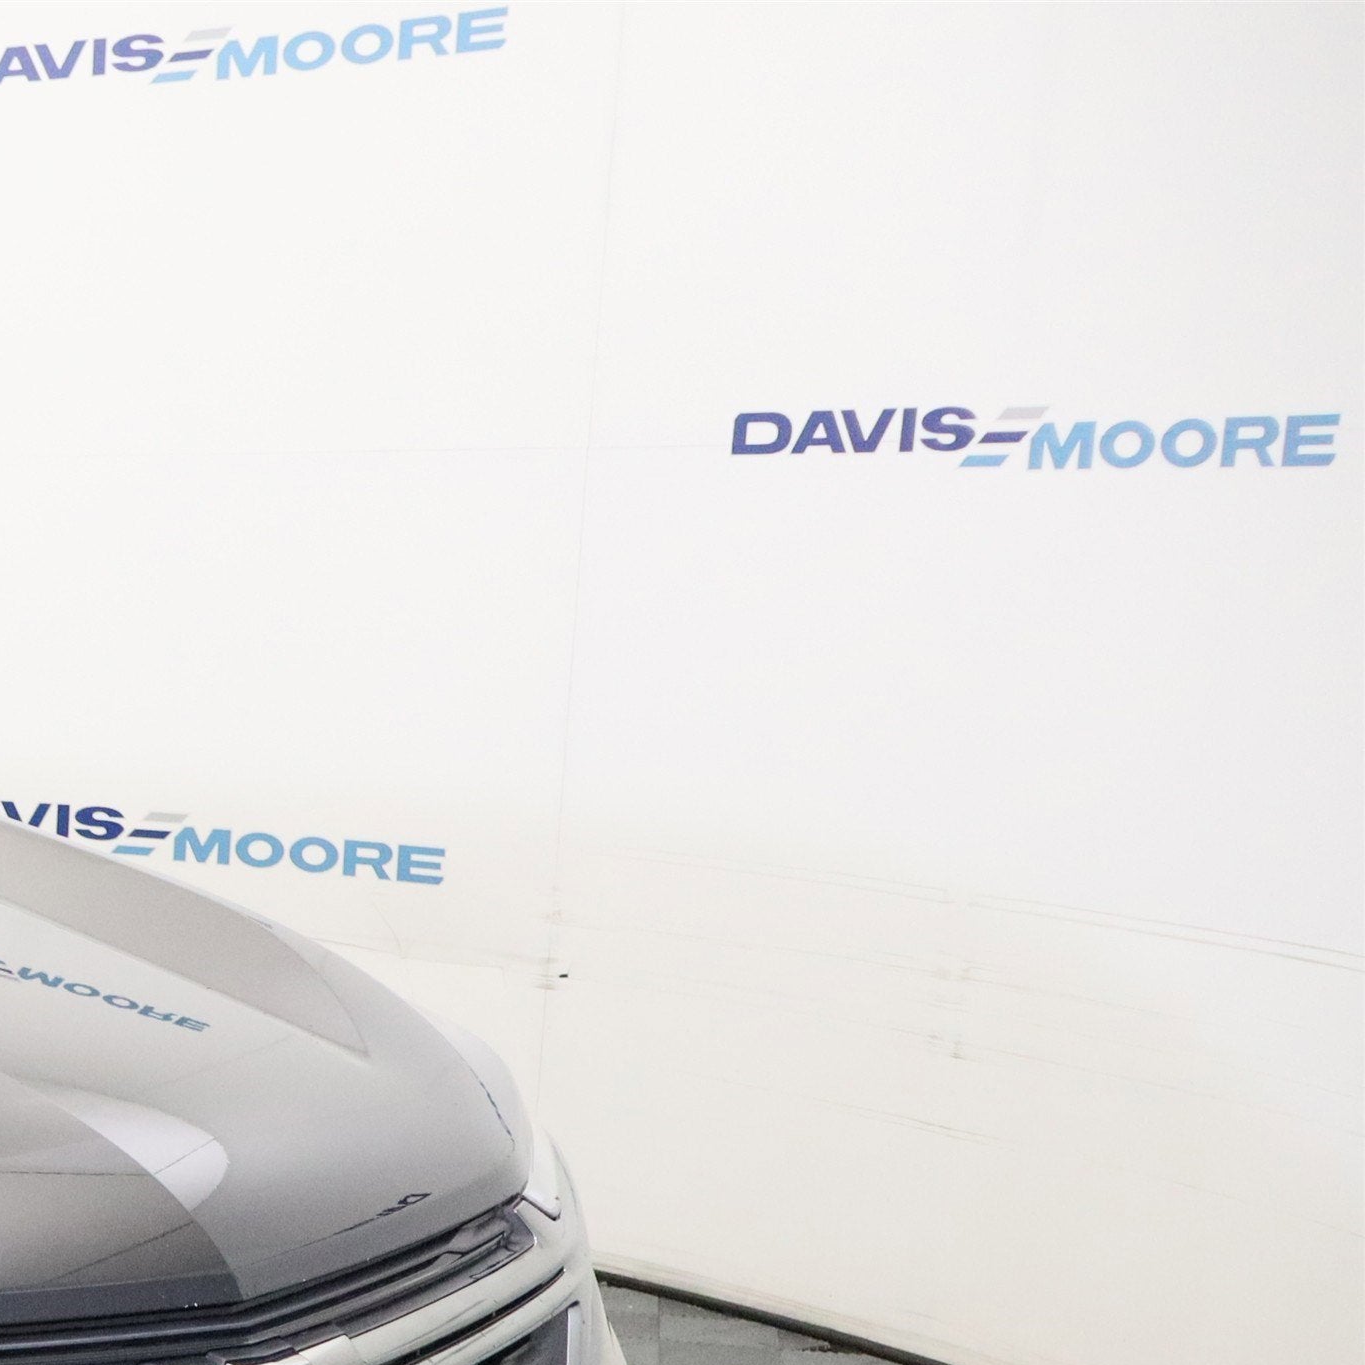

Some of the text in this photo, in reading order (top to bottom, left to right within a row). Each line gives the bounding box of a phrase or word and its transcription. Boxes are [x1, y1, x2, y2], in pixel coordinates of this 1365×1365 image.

[216, 5, 509, 81] MOORE
[731, 406, 1342, 470] DAVIS MOORE
[172, 826, 446, 885] MOORE
